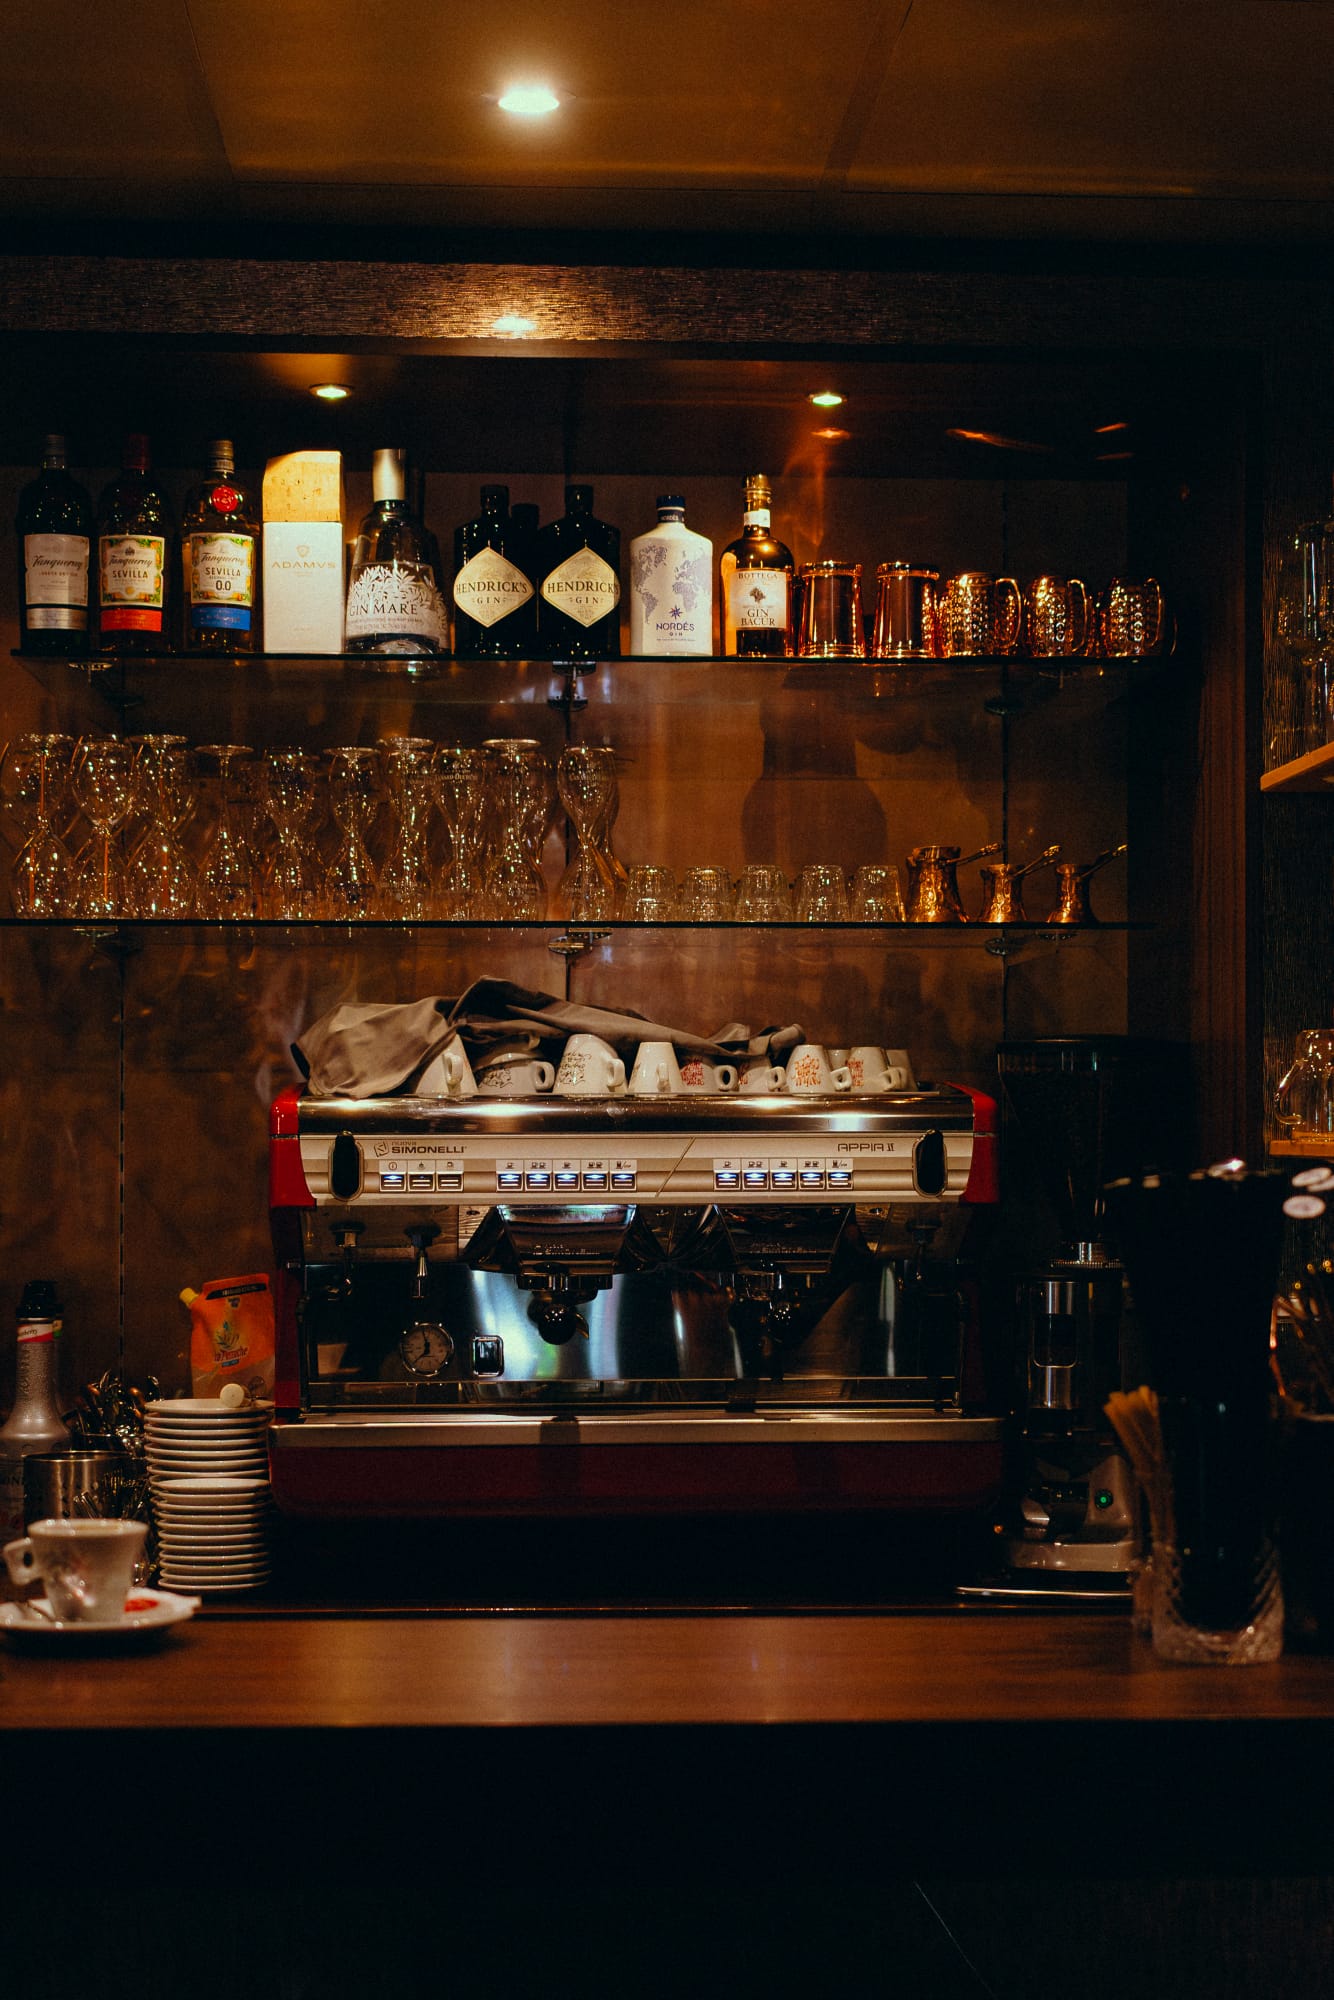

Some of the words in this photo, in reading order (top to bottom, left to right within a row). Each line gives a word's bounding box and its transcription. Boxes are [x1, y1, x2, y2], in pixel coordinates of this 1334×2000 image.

[32, 555, 83, 570] Tanqueray
[109, 555, 153, 568] Tanqueray
[271, 561, 336, 569] ADAMVS
[112, 570, 148, 578] SEVILLA
[205, 567, 241, 576] SEVILLA
[738, 572, 778, 580] BOTTEGA
[215, 580, 232, 591] 0.0
[456, 581, 528, 594] HENDRICK'S
[476, 596, 501, 604] GIN
[575, 596, 599, 604] GIN
[350, 605, 369, 617] GIN
[373, 603, 418, 615] MARE
[747, 608, 769, 617] GIN
[655, 622, 695, 631] NORDÉS
[741, 618, 776, 626] BACUR
[391, 1146, 465, 1154] SIMONELLI
[837, 1143, 885, 1153] APPIA
